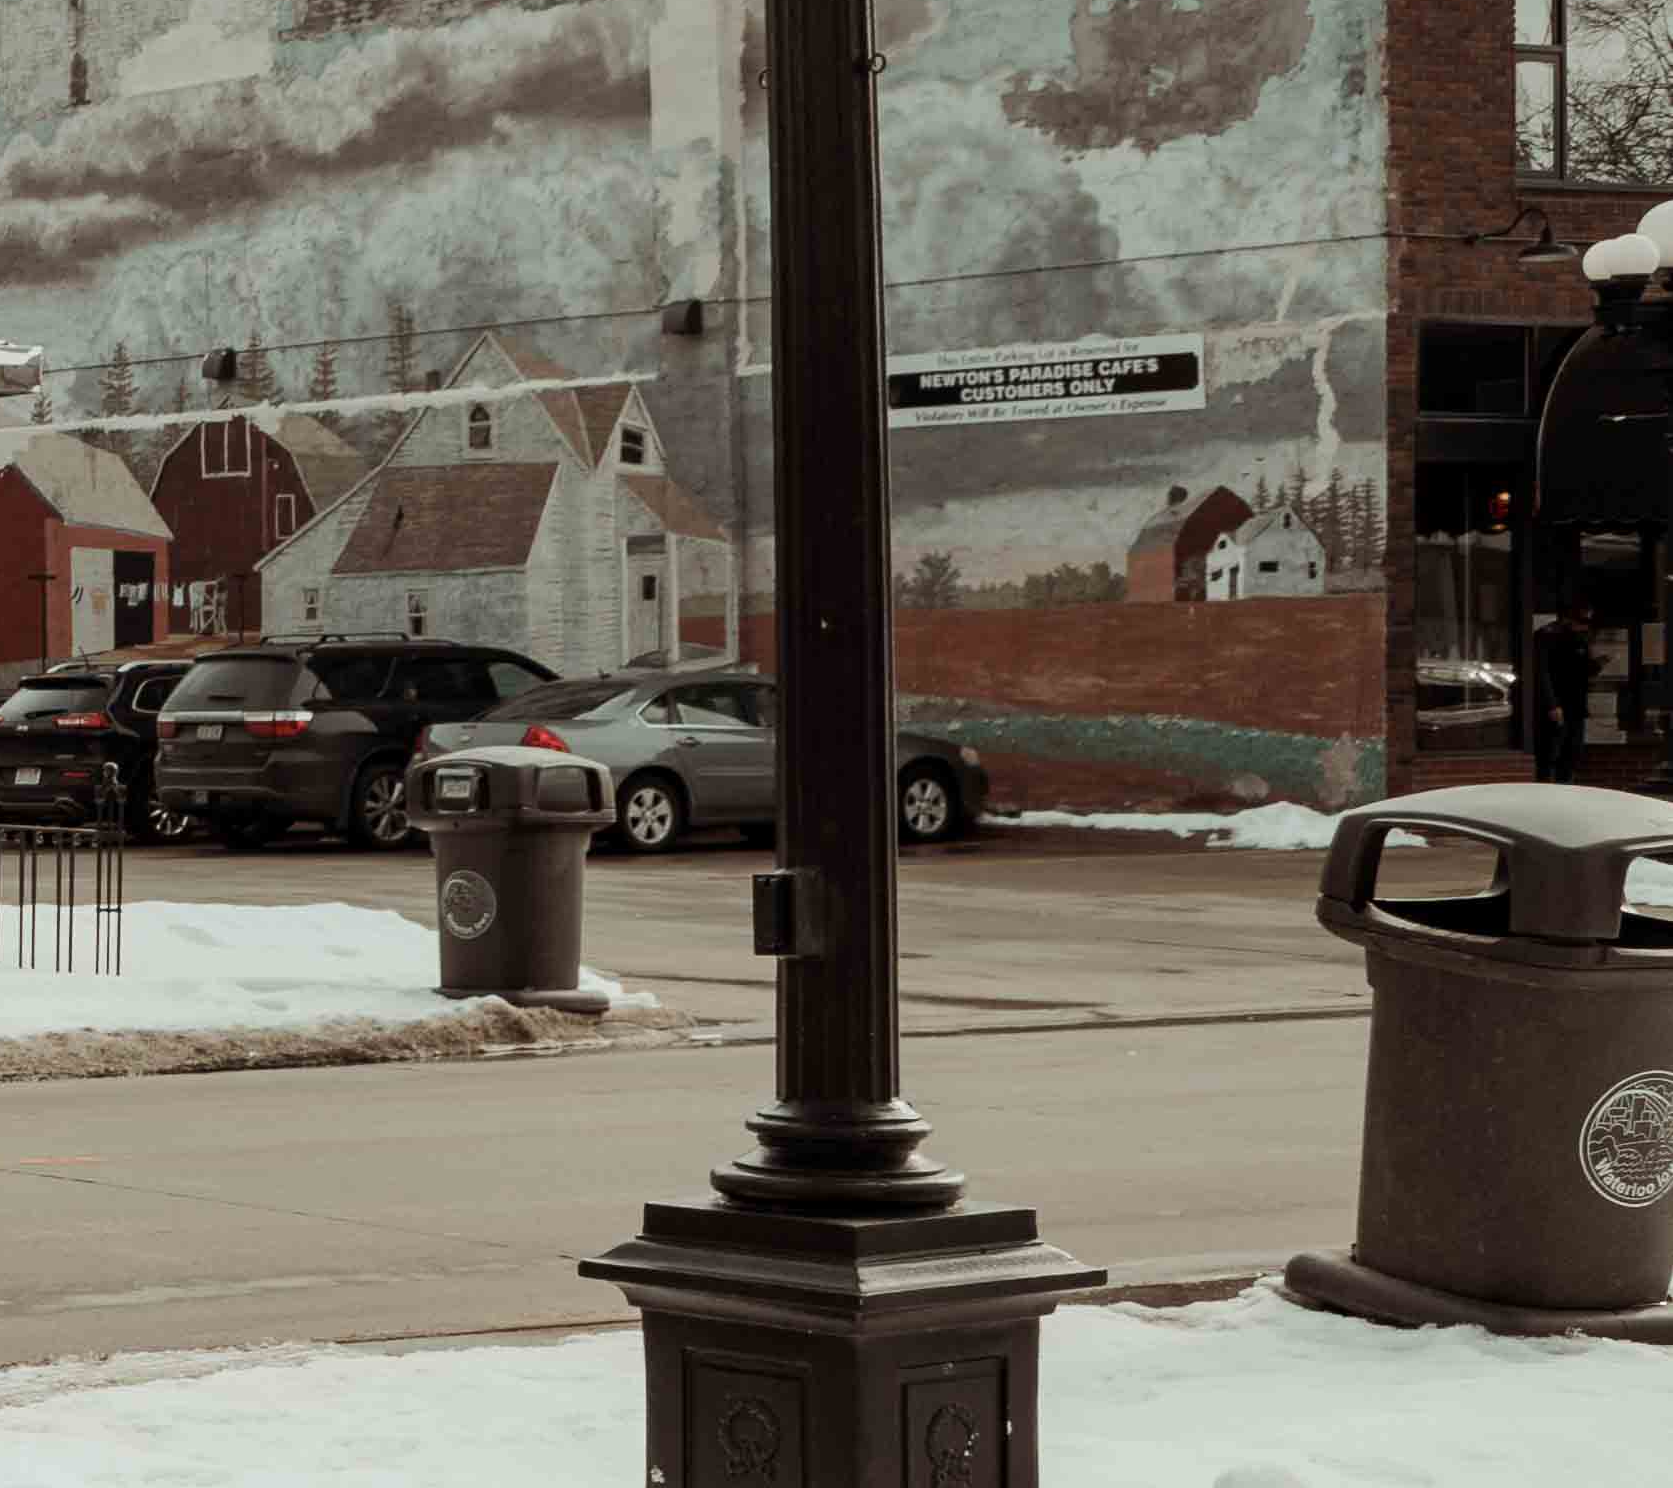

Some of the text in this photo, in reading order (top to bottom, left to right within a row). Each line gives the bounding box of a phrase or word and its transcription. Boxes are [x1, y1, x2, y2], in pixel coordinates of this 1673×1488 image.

[919, 357, 1159, 389] NEWTON'S PARADISE CAFE'S
[960, 378, 1117, 402] CUSTOMERS ONLY
[1594, 1156, 1673, 1197] Waterloo Io
